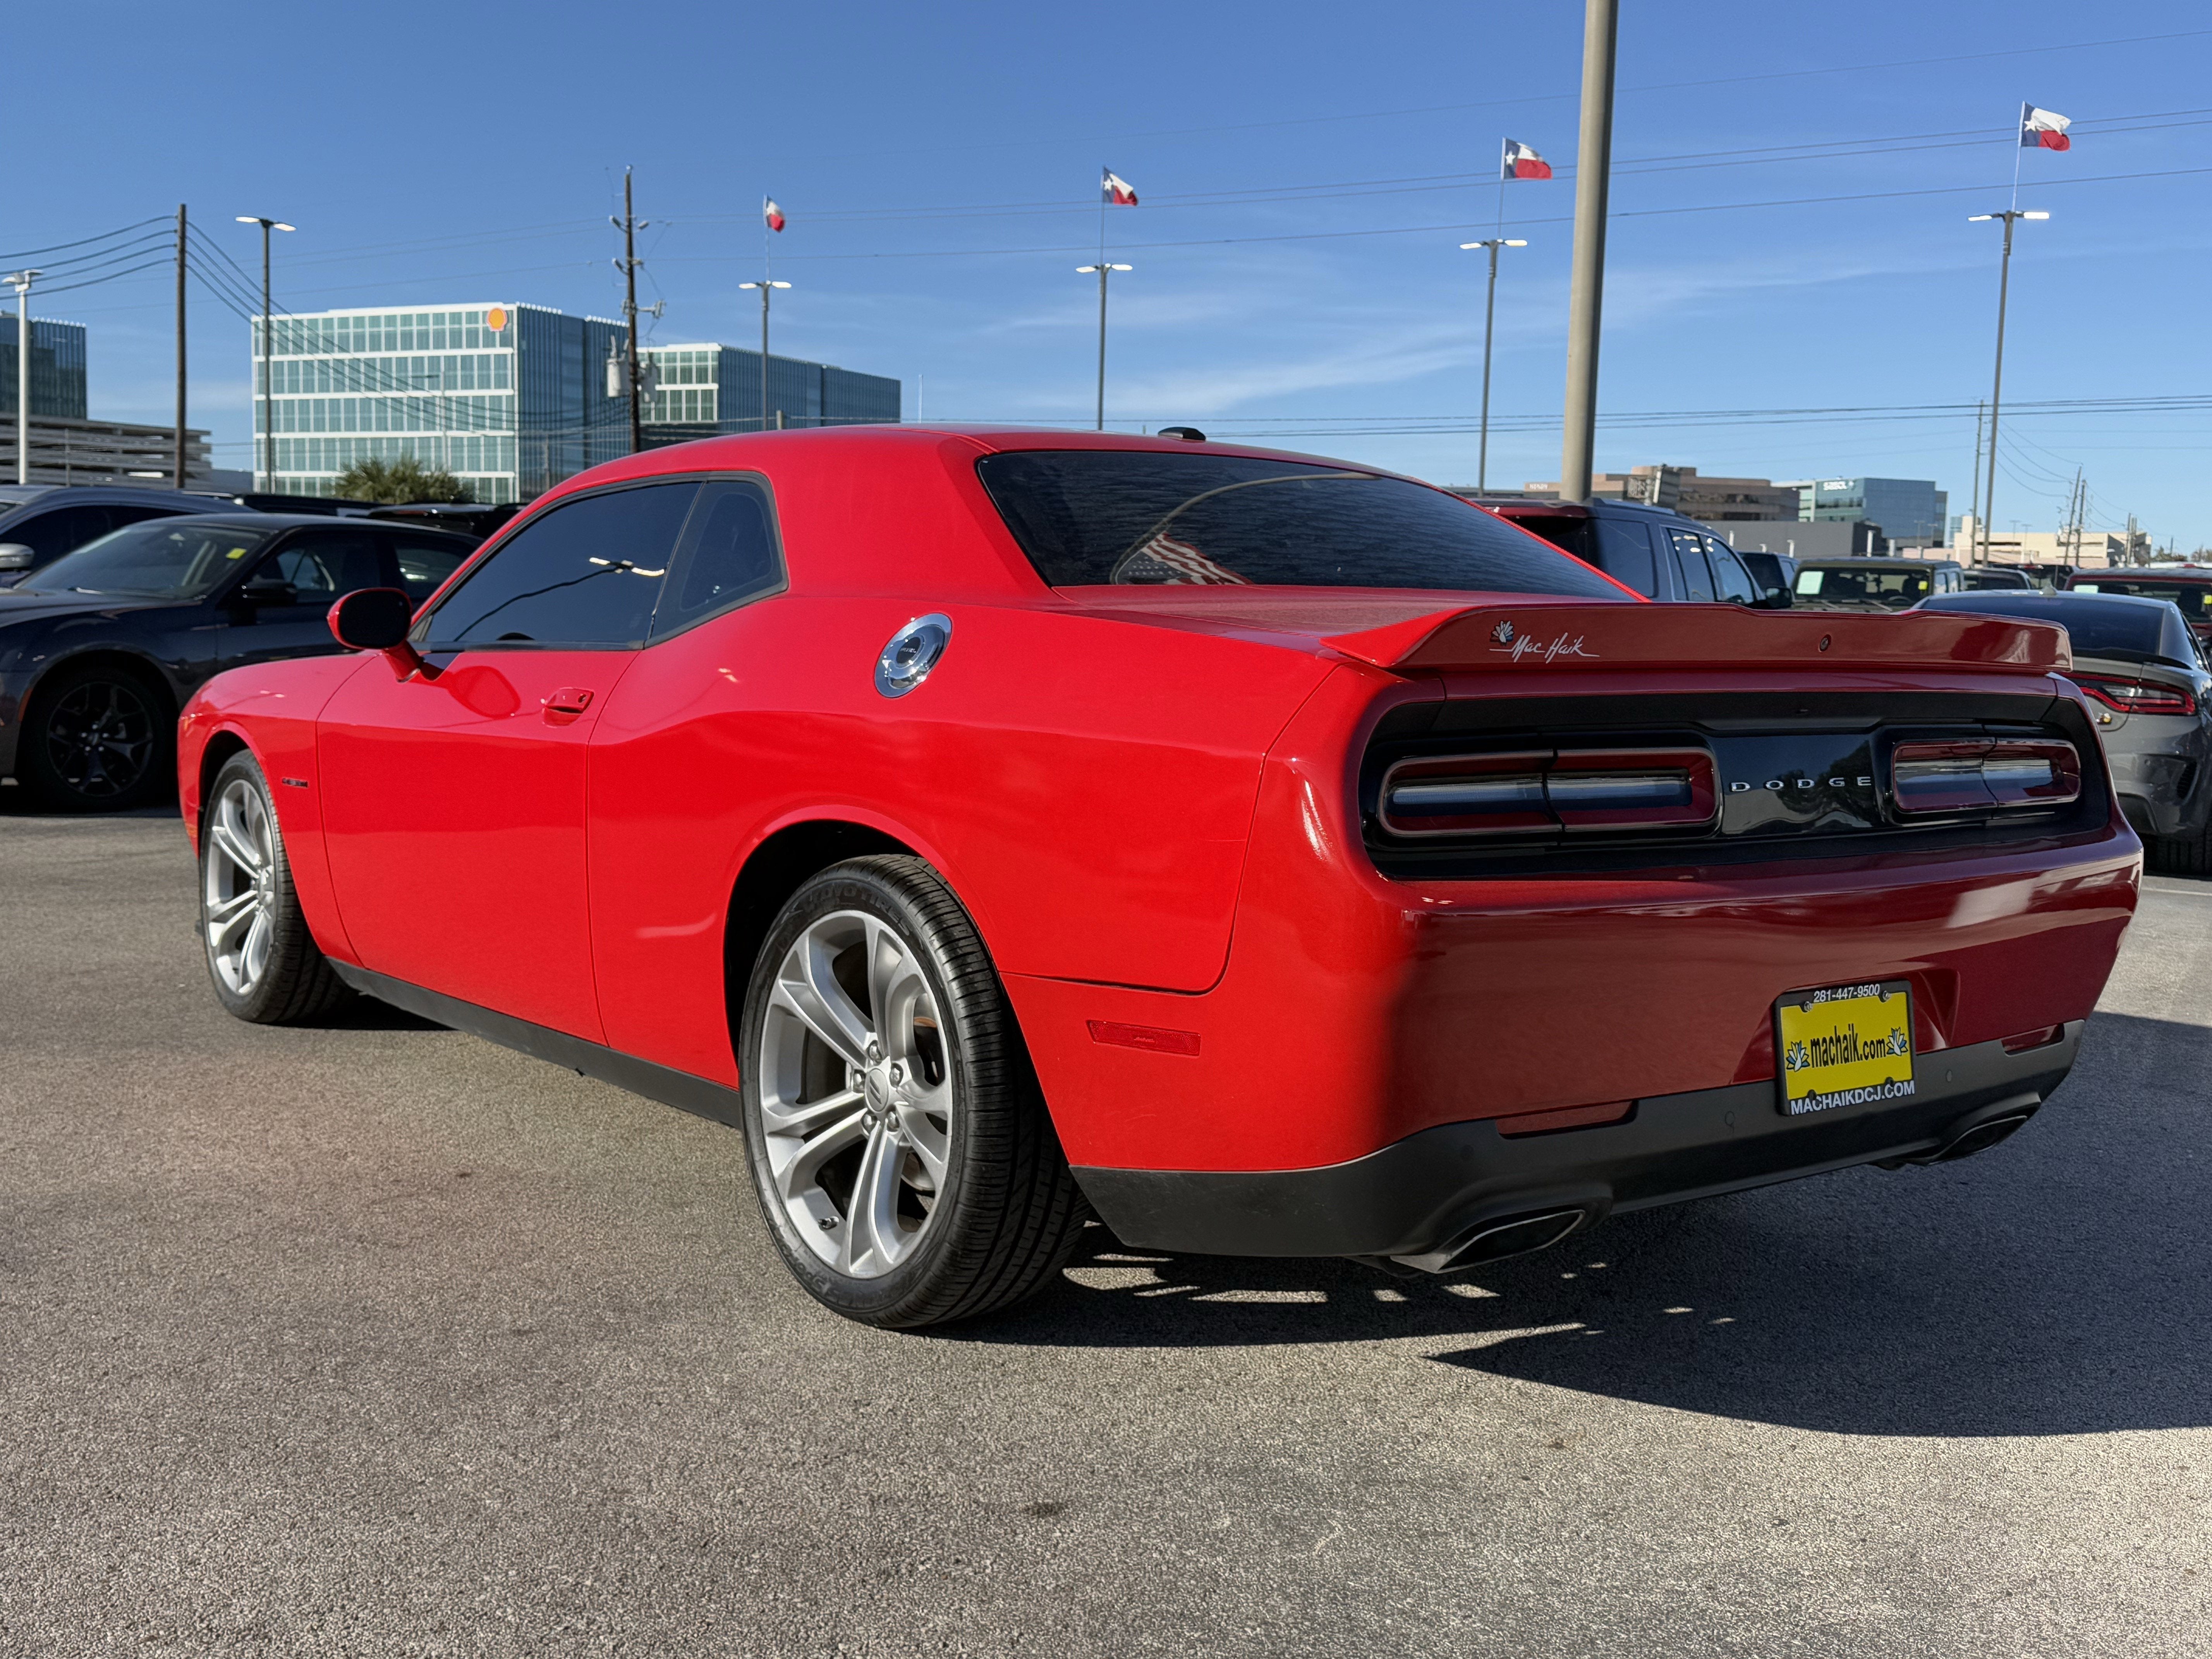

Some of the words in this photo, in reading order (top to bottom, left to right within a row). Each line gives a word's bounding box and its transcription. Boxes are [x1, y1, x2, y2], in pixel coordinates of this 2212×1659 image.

[1489, 634, 1545, 663] Mac
[1544, 632, 1600, 664] Haik
[1731, 776, 1872, 792] DODGE
[1813, 984, 1881, 1003] 281-447-9500
[1810, 1023, 1886, 1068] machaik.com
[1790, 1080, 1915, 1115] MACHAIKDCJ.COM
